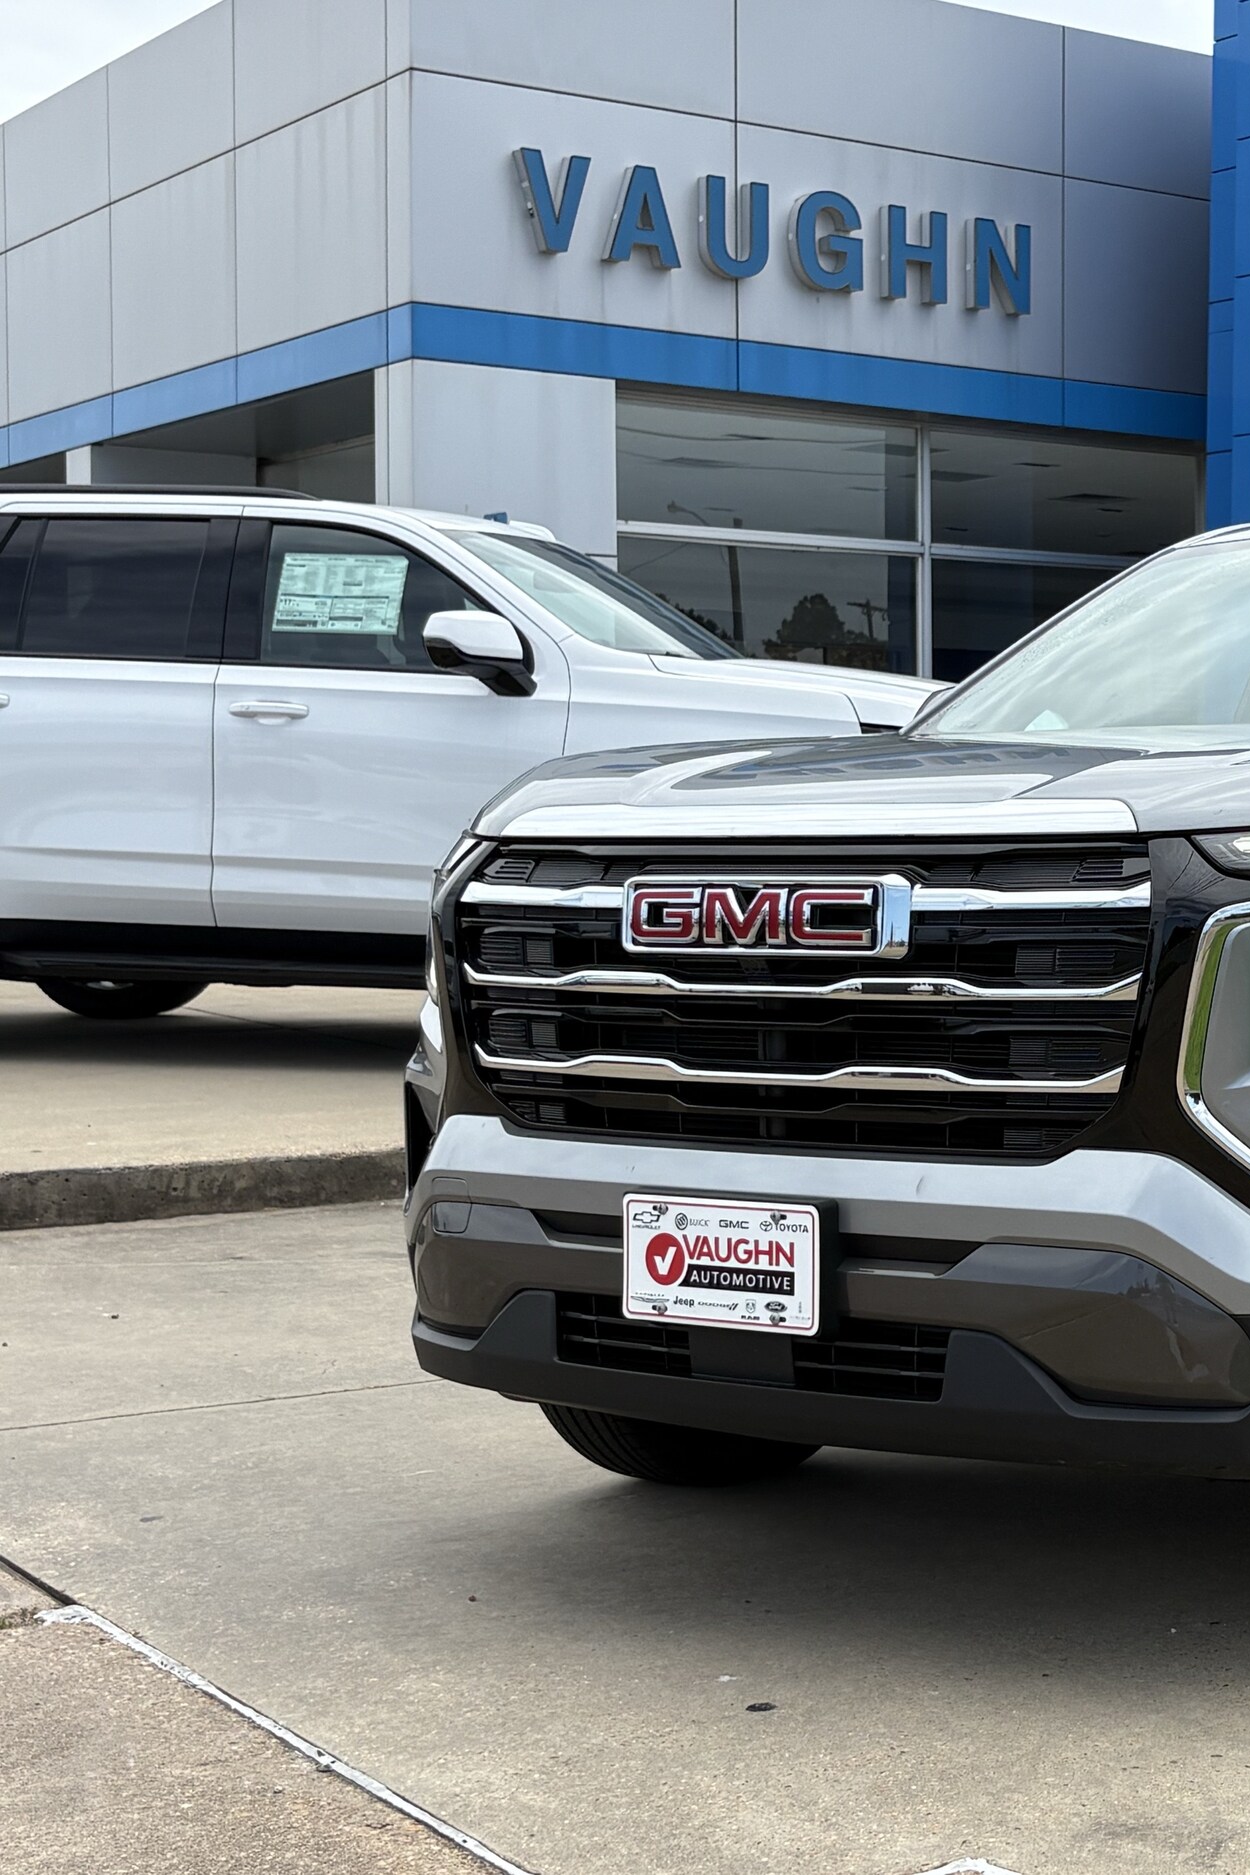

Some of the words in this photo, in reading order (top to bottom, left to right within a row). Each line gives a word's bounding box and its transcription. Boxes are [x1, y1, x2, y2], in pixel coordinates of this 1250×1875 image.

[512, 147, 1031, 316] VAUGHN
[631, 886, 874, 947] GMC
[719, 1219, 750, 1229] GMC
[682, 1234, 795, 1268] VAUGHN
[690, 1269, 791, 1290] AUTOMOTIVE
[673, 1296, 695, 1308] Jeep
